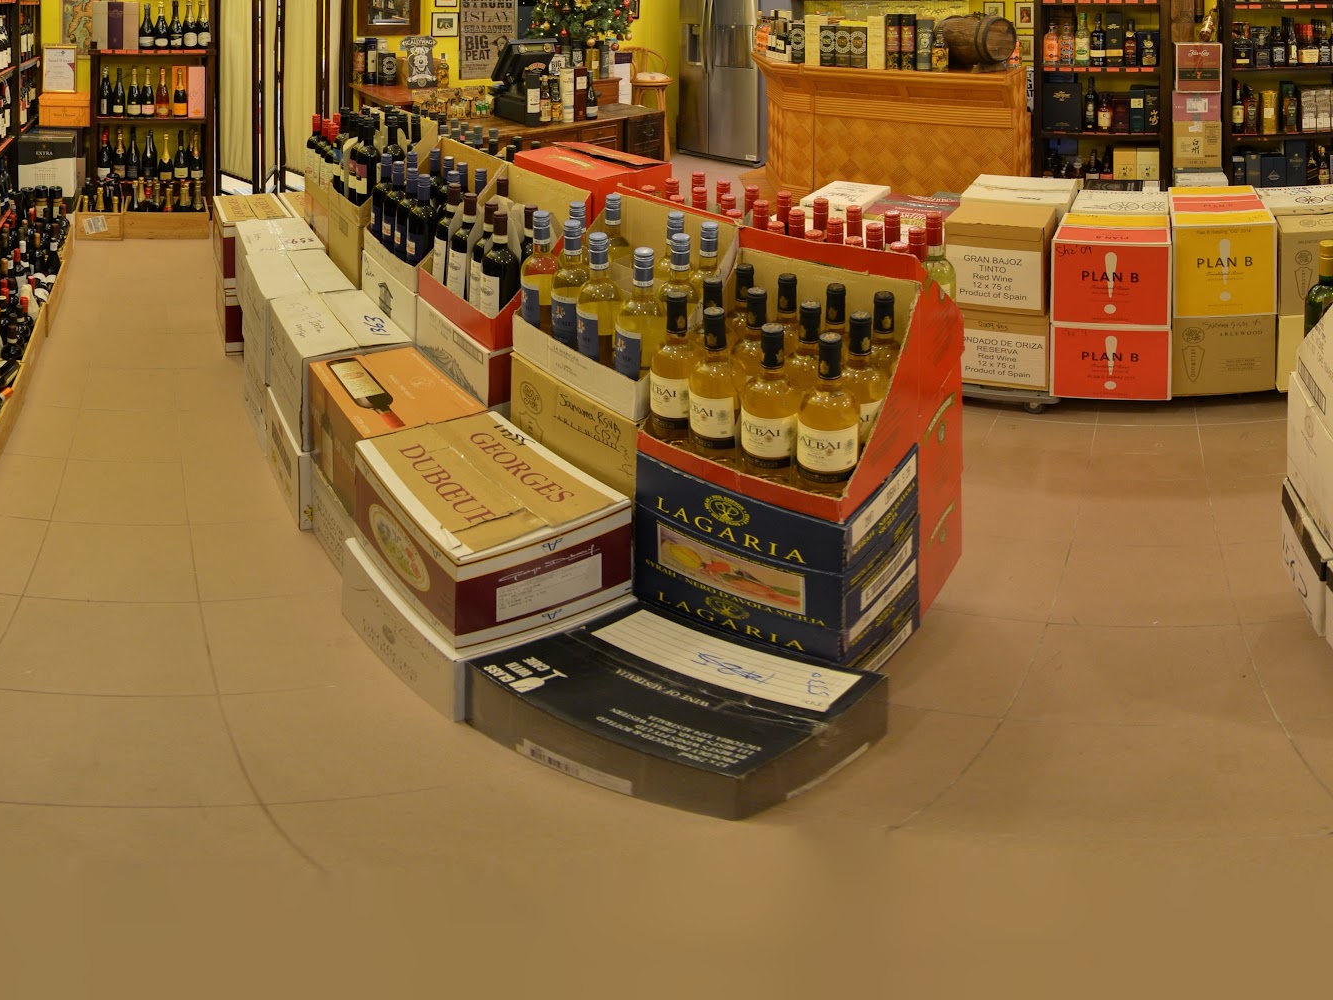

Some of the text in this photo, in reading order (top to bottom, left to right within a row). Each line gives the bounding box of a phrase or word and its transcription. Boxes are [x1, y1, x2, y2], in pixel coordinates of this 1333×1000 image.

[464, 11, 512, 24] ISLAY
[463, 24, 513, 34] CHARACTER
[464, 35, 489, 50] BIG
[465, 49, 491, 62] PEAT
[963, 254, 1023, 267] GRAN BAJOZ
[1196, 256, 1254, 269] PLAN B
[979, 264, 1007, 274] TINTO
[972, 272, 1013, 283] Red Wine
[1081, 270, 1140, 283] PLAN B
[972, 281, 982, 289] 12
[991, 282, 1002, 291] 75
[959, 288, 1027, 302] Product of Spain
[976, 345, 1019, 355] RESERVA
[1000, 339, 1044, 350] DE ORIZA
[978, 353, 1017, 363] Red Wine
[1081, 351, 1140, 363] PLAN B
[996, 361, 1008, 369] 75
[964, 366, 1031, 380] Product of Spain
[468, 430, 575, 504] GEORGES
[656, 496, 808, 565] LAGARIA
[644, 558, 677, 578] SYRAH
[684, 572, 710, 592] NERO
[773, 608, 827, 628] SICILIA
[657, 591, 807, 653] LAGARIA
[504, 660, 532, 679] WITH
[522, 655, 547, 673] CARE
[482, 664, 511, 684] GLASS
[615, 667, 710, 708] WINE OF AUSTRALIA
